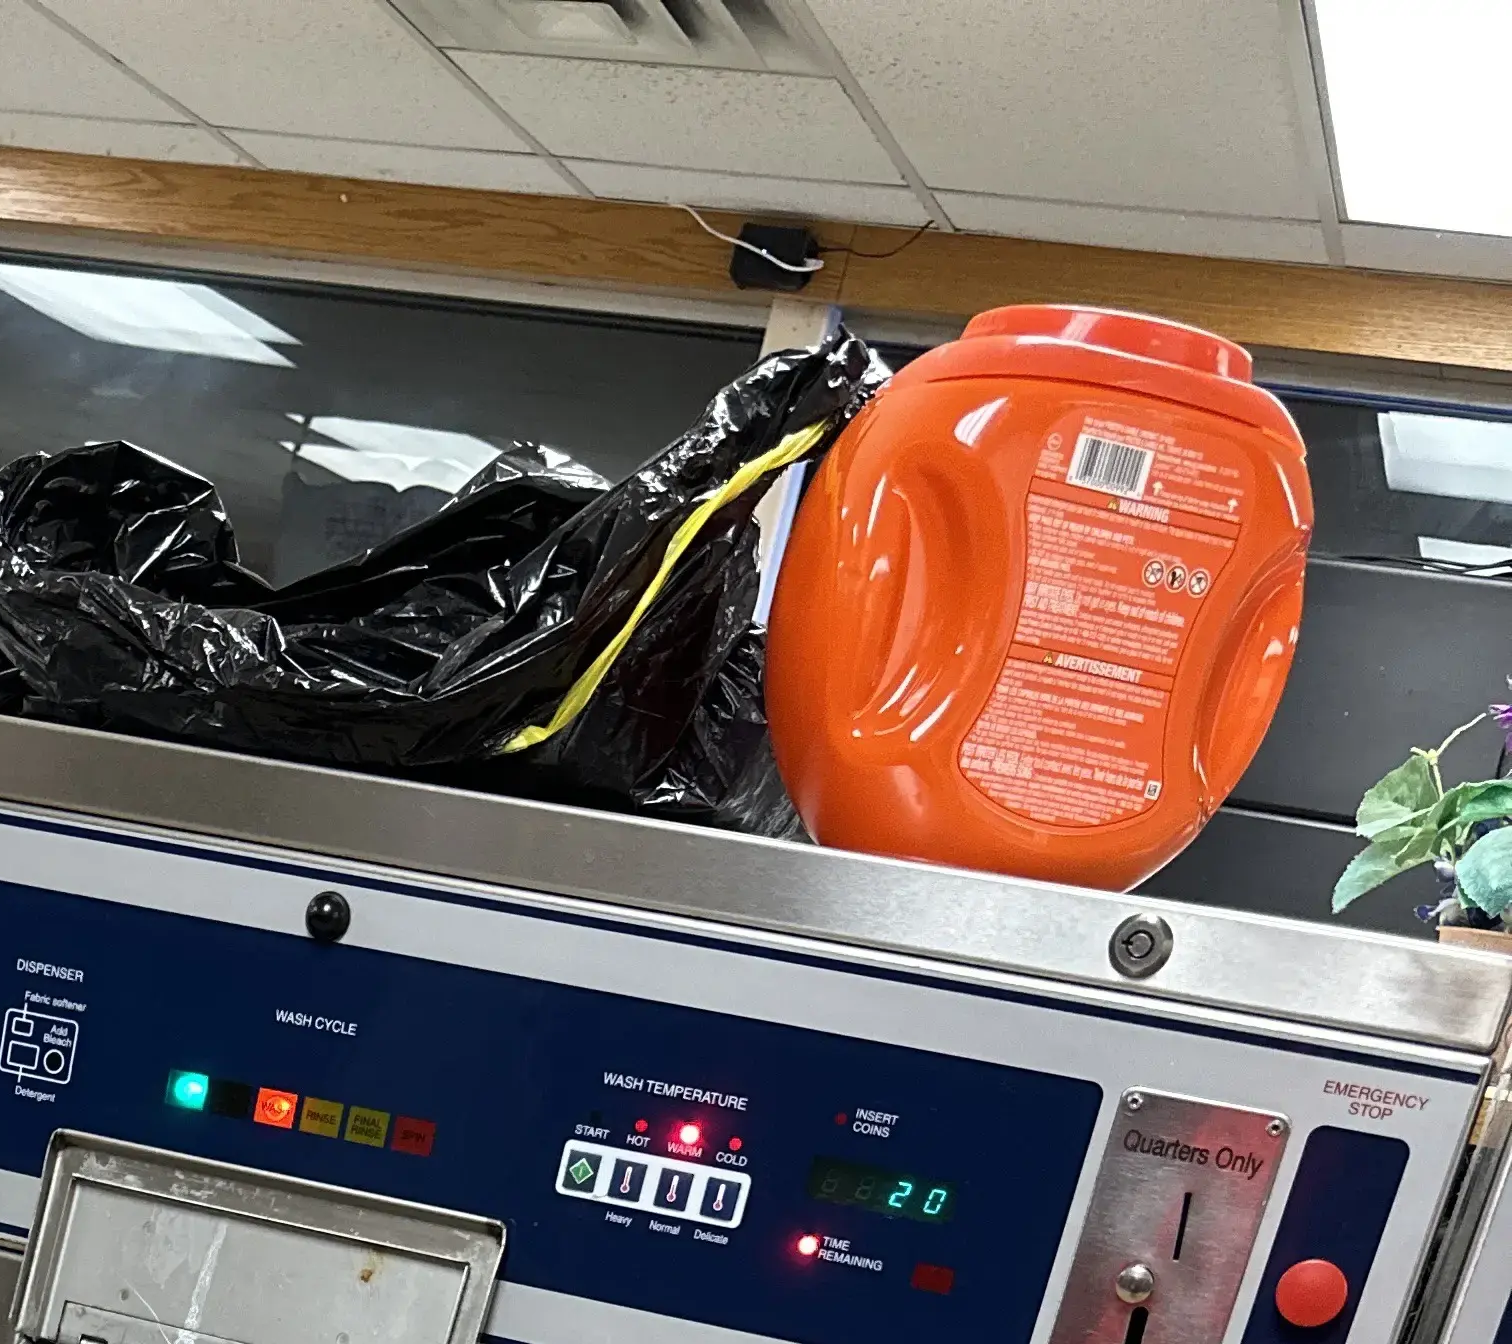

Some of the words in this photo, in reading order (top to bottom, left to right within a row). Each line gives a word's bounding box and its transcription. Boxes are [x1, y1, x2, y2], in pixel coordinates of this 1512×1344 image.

[1118, 500, 1169, 522] WARNING
[1055, 654, 1143, 683] AVERTISSEMENT
[16, 958, 84, 984] DISPENSER
[24, 990, 51, 1007] Fabric
[51, 997, 87, 1012] softener
[50, 1024, 68, 1037] Add
[275, 1009, 313, 1029] WASH
[314, 1017, 357, 1037] CYCLE
[43, 1032, 72, 1048] Bleach
[14, 1085, 55, 1103] Detergent
[603, 1072, 643, 1092] WASH
[646, 1079, 748, 1111] TEMPERATURE
[1323, 1080, 1429, 1111] EMERGENCY
[306, 1110, 337, 1126] RINSE
[855, 1108, 899, 1127] INSERT
[1348, 1102, 1393, 1121] STOP
[353, 1114, 381, 1129] FINAL
[852, 1120, 890, 1138] COINS
[350, 1125, 381, 1140] RINSE
[400, 1130, 426, 1144] SPIN
[575, 1123, 610, 1140] START
[626, 1133, 650, 1148] HOT
[667, 1141, 702, 1158] WARM
[1123, 1128, 1210, 1165] Quarters
[1214, 1147, 1264, 1180] Only
[716, 1151, 748, 1167] COLD
[889, 1181, 947, 1215] 20
[605, 1210, 633, 1228] Heavy
[649, 1219, 680, 1235] Normal
[693, 1228, 729, 1245] Delicate
[822, 1236, 850, 1252] TIME
[817, 1247, 883, 1272] REMAINING
